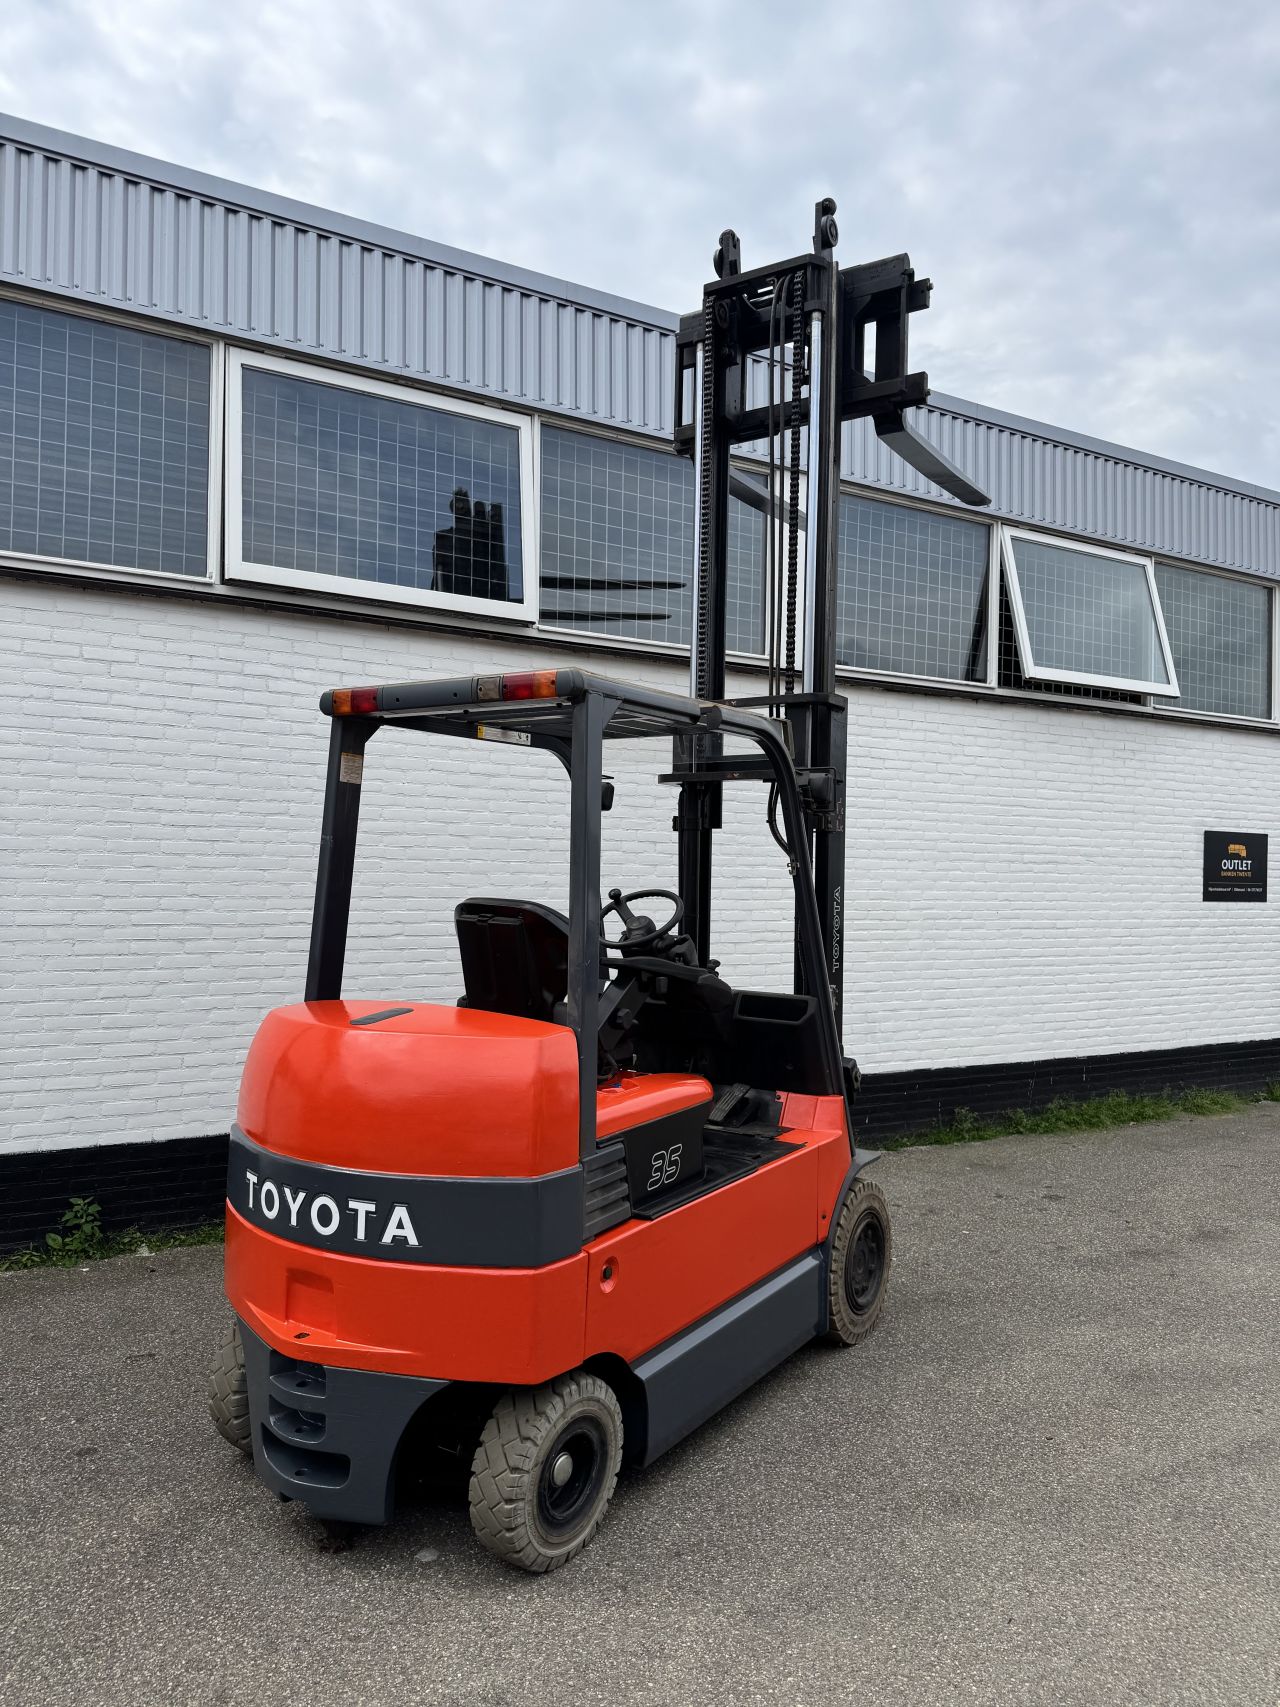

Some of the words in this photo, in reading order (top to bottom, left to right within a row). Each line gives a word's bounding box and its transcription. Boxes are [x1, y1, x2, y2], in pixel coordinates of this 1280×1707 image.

[1221, 859, 1252, 871] OUTLET
[832, 886, 841, 973] TOYOTA
[647, 1143, 682, 1191] 35
[246, 1170, 420, 1246] TOYOTA
